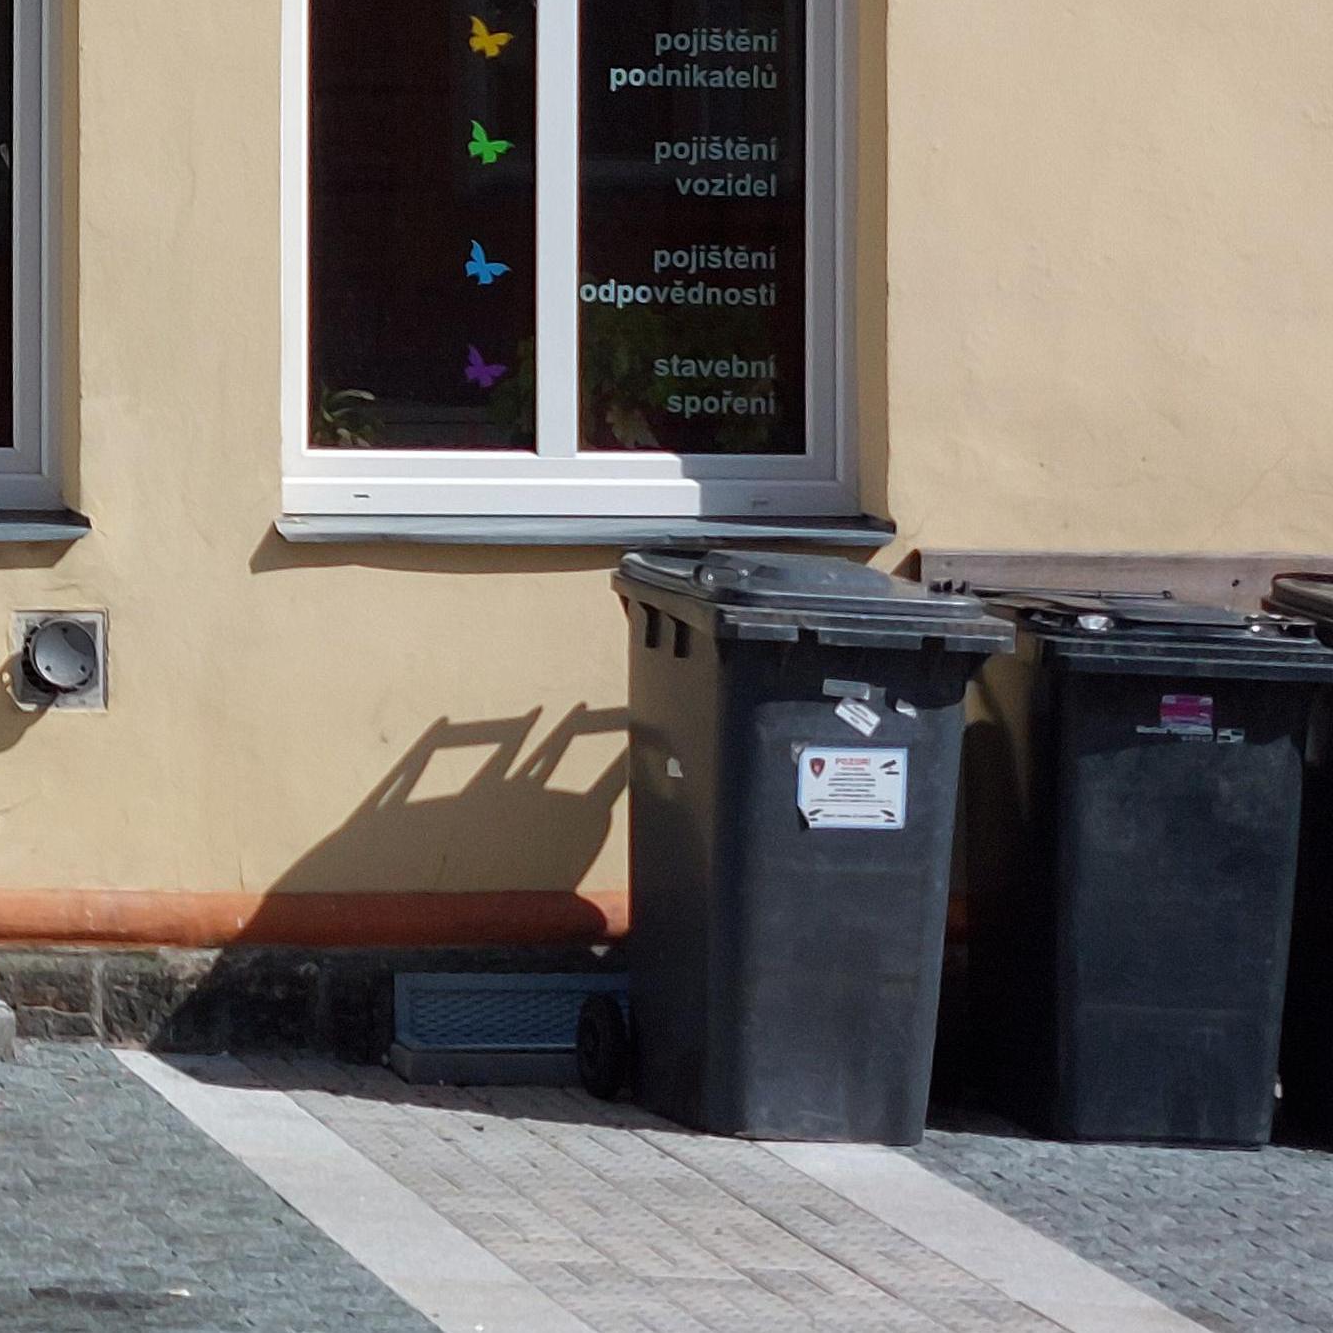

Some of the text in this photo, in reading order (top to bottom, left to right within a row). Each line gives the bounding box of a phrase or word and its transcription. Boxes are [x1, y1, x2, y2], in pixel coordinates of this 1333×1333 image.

[655, 28, 777, 56] pojištění
[610, 64, 777, 91] podnikatelů
[654, 137, 777, 165] pojištění
[675, 173, 776, 197] vozidel
[654, 245, 776, 273] pojištění
[580, 279, 776, 308] odpovědnosti
[653, 354, 775, 378] stavební
[667, 391, 775, 418] spoření
